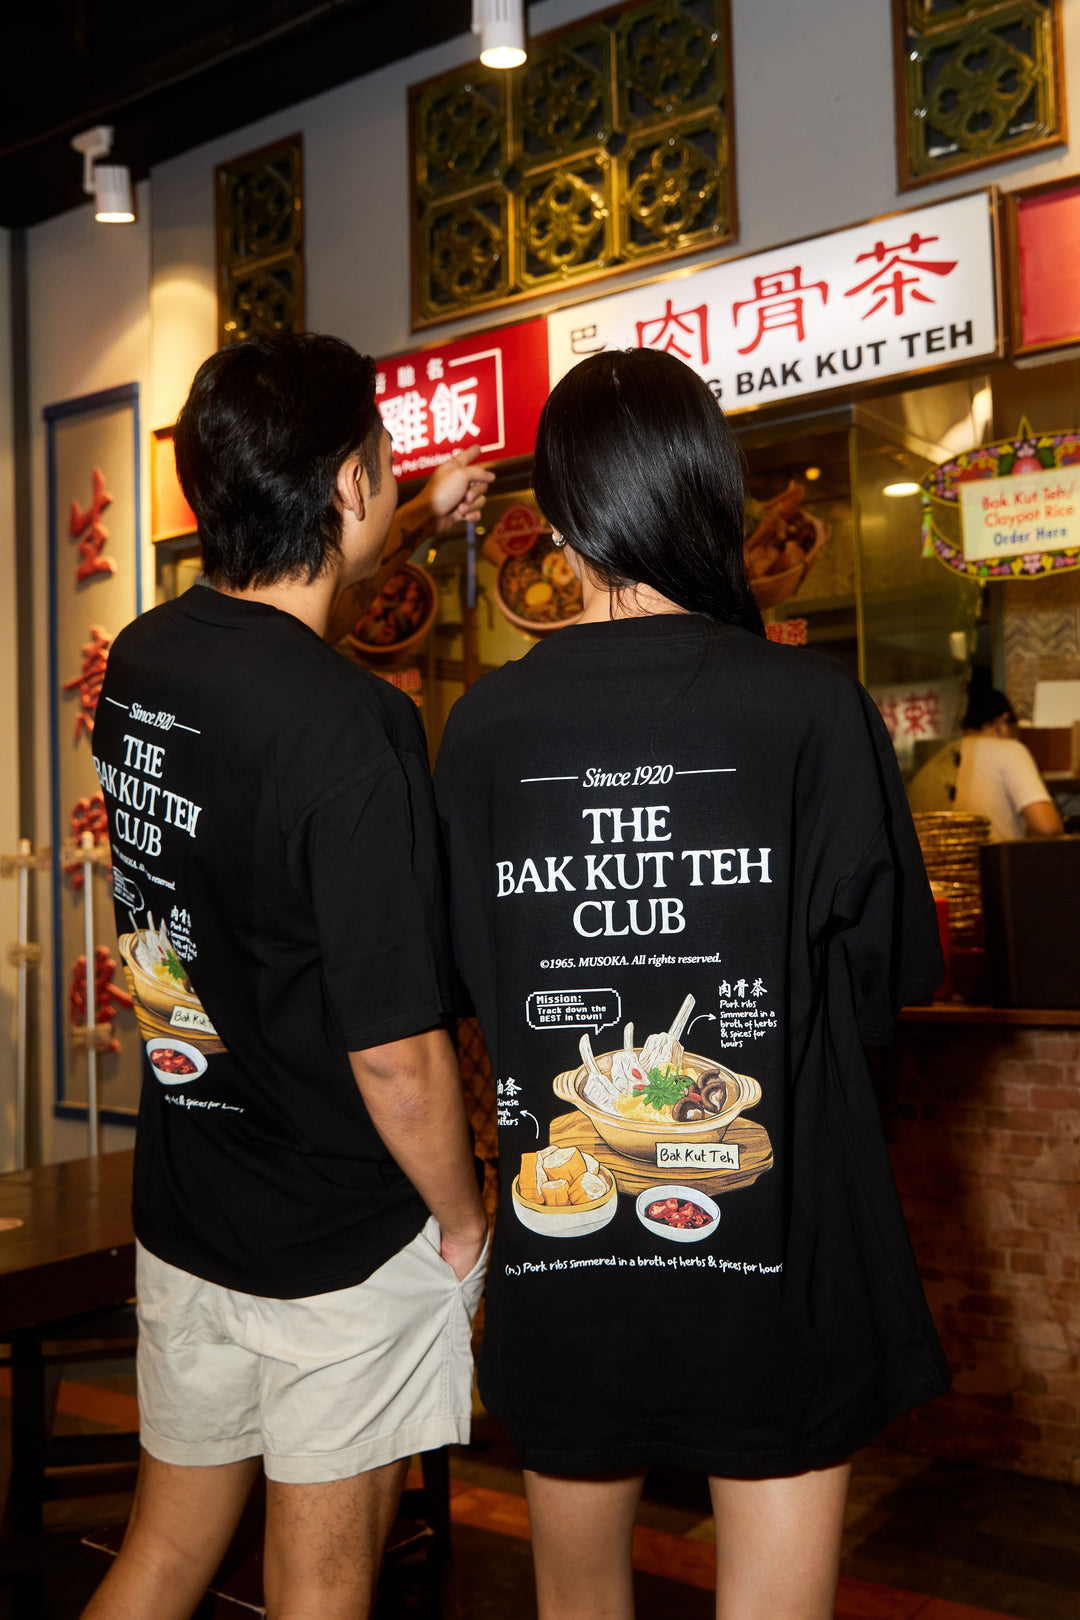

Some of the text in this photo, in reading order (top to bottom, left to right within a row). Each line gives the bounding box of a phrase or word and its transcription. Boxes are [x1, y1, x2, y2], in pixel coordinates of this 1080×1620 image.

[636, 232, 958, 366] 肉骨茶
[737, 359, 801, 396] BAK
[816, 340, 886, 378] KUT
[901, 320, 974, 358] TEH
[982, 494, 1008, 511] Bak
[1014, 491, 1038, 506] Kut
[984, 505, 1074, 528] Claypot Rice
[993, 527, 1067, 546] Order Here
[129, 702, 175, 731] Since 1920
[123, 734, 166, 779] THE
[582, 764, 674, 788] Since 1920
[118, 771, 161, 817] KUT
[162, 790, 202, 838] TEH
[115, 808, 162, 857] CLUB
[582, 805, 672, 844] THE
[496, 847, 773, 898] BAK KUT TEH
[572, 897, 687, 938] CLUB
[578, 955, 630, 967] MUSOKA.
[631, 954, 646, 965] All
[647, 953, 676, 967] rights
[677, 952, 722, 964] reserved.
[719, 977, 768, 998] 肉骨茶
[536, 994, 582, 1004] Mission:
[720, 999, 757, 1009] Pork ribs
[174, 1010, 191, 1022] Bak
[537, 1007, 562, 1015] Track
[539, 1014, 561, 1023] BEST
[575, 1012, 603, 1020] town!
[720, 1009, 759, 1019] simmered
[760, 1010, 768, 1018] in
[720, 1018, 778, 1030] broth of herbs
[720, 1028, 766, 1041] & spices for
[720, 1039, 744, 1049] hours
[660, 1148, 735, 1165] Bak Kut Teh
[504, 1264, 521, 1276] (n.)
[522, 1261, 547, 1273] Pork
[549, 1259, 567, 1271] ribs
[569, 1255, 616, 1269] simmered
[617, 1257, 628, 1266] in
[629, 1258, 636, 1267] a
[637, 1255, 666, 1267] broth
[667, 1256, 677, 1270] of
[678, 1255, 706, 1268] herbs
[707, 1255, 718, 1269] &
[718, 1259, 742, 1273] spices
[742, 1261, 758, 1275] for
